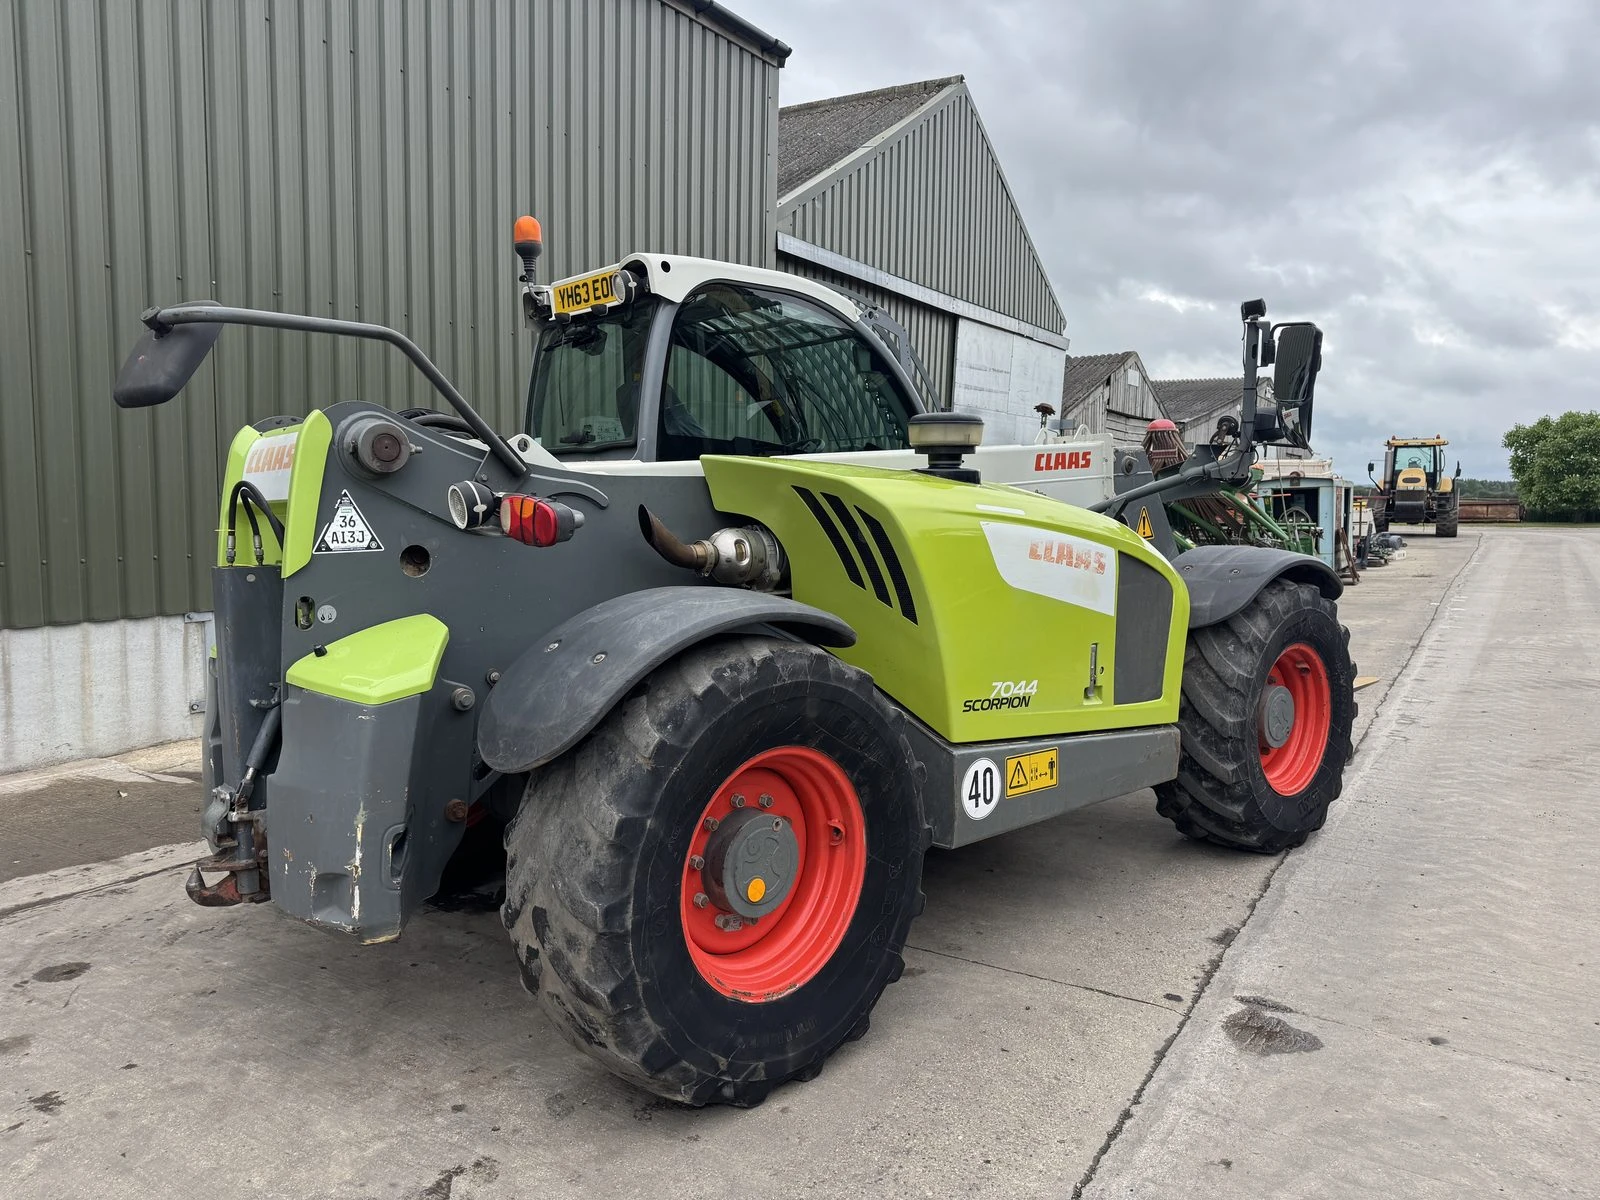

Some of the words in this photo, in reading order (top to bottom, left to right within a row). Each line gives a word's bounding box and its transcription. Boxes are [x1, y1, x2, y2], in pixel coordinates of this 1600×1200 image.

[558, 282, 590, 309] YH63
[1034, 451, 1092, 472] CLAAS
[339, 515, 356, 528] 36
[1028, 541, 1106, 575] CLAAS
[990, 679, 1038, 698] 7044
[962, 695, 1031, 712] SCORPION
[968, 766, 994, 808] 40
